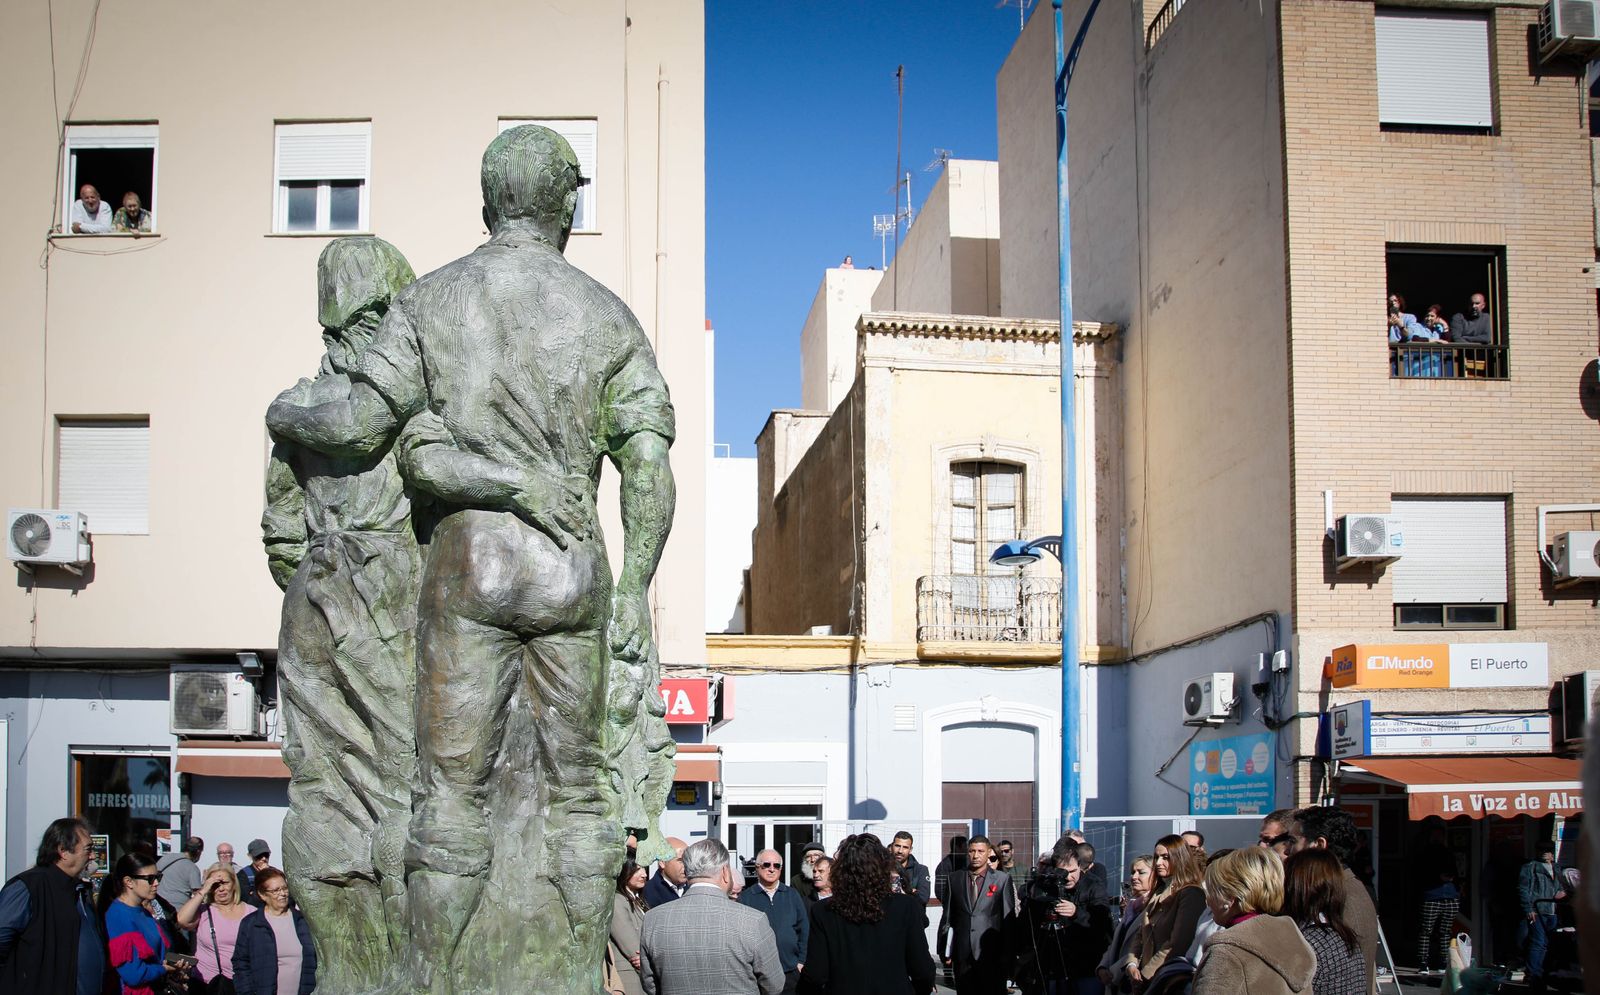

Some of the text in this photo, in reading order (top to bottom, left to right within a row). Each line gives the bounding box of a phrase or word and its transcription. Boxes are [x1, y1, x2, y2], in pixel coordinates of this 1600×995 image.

[1336, 656, 1353, 672] Ria
[1385, 656, 1434, 669] Mundo
[1470, 658, 1528, 670] El Puerto
[1485, 724, 1516, 732] Puerto
[88, 793, 170, 809] REFRESQUERIA
[1442, 795, 1464, 812] la
[1469, 793, 1507, 811] Voz
[1514, 792, 1540, 810] de
